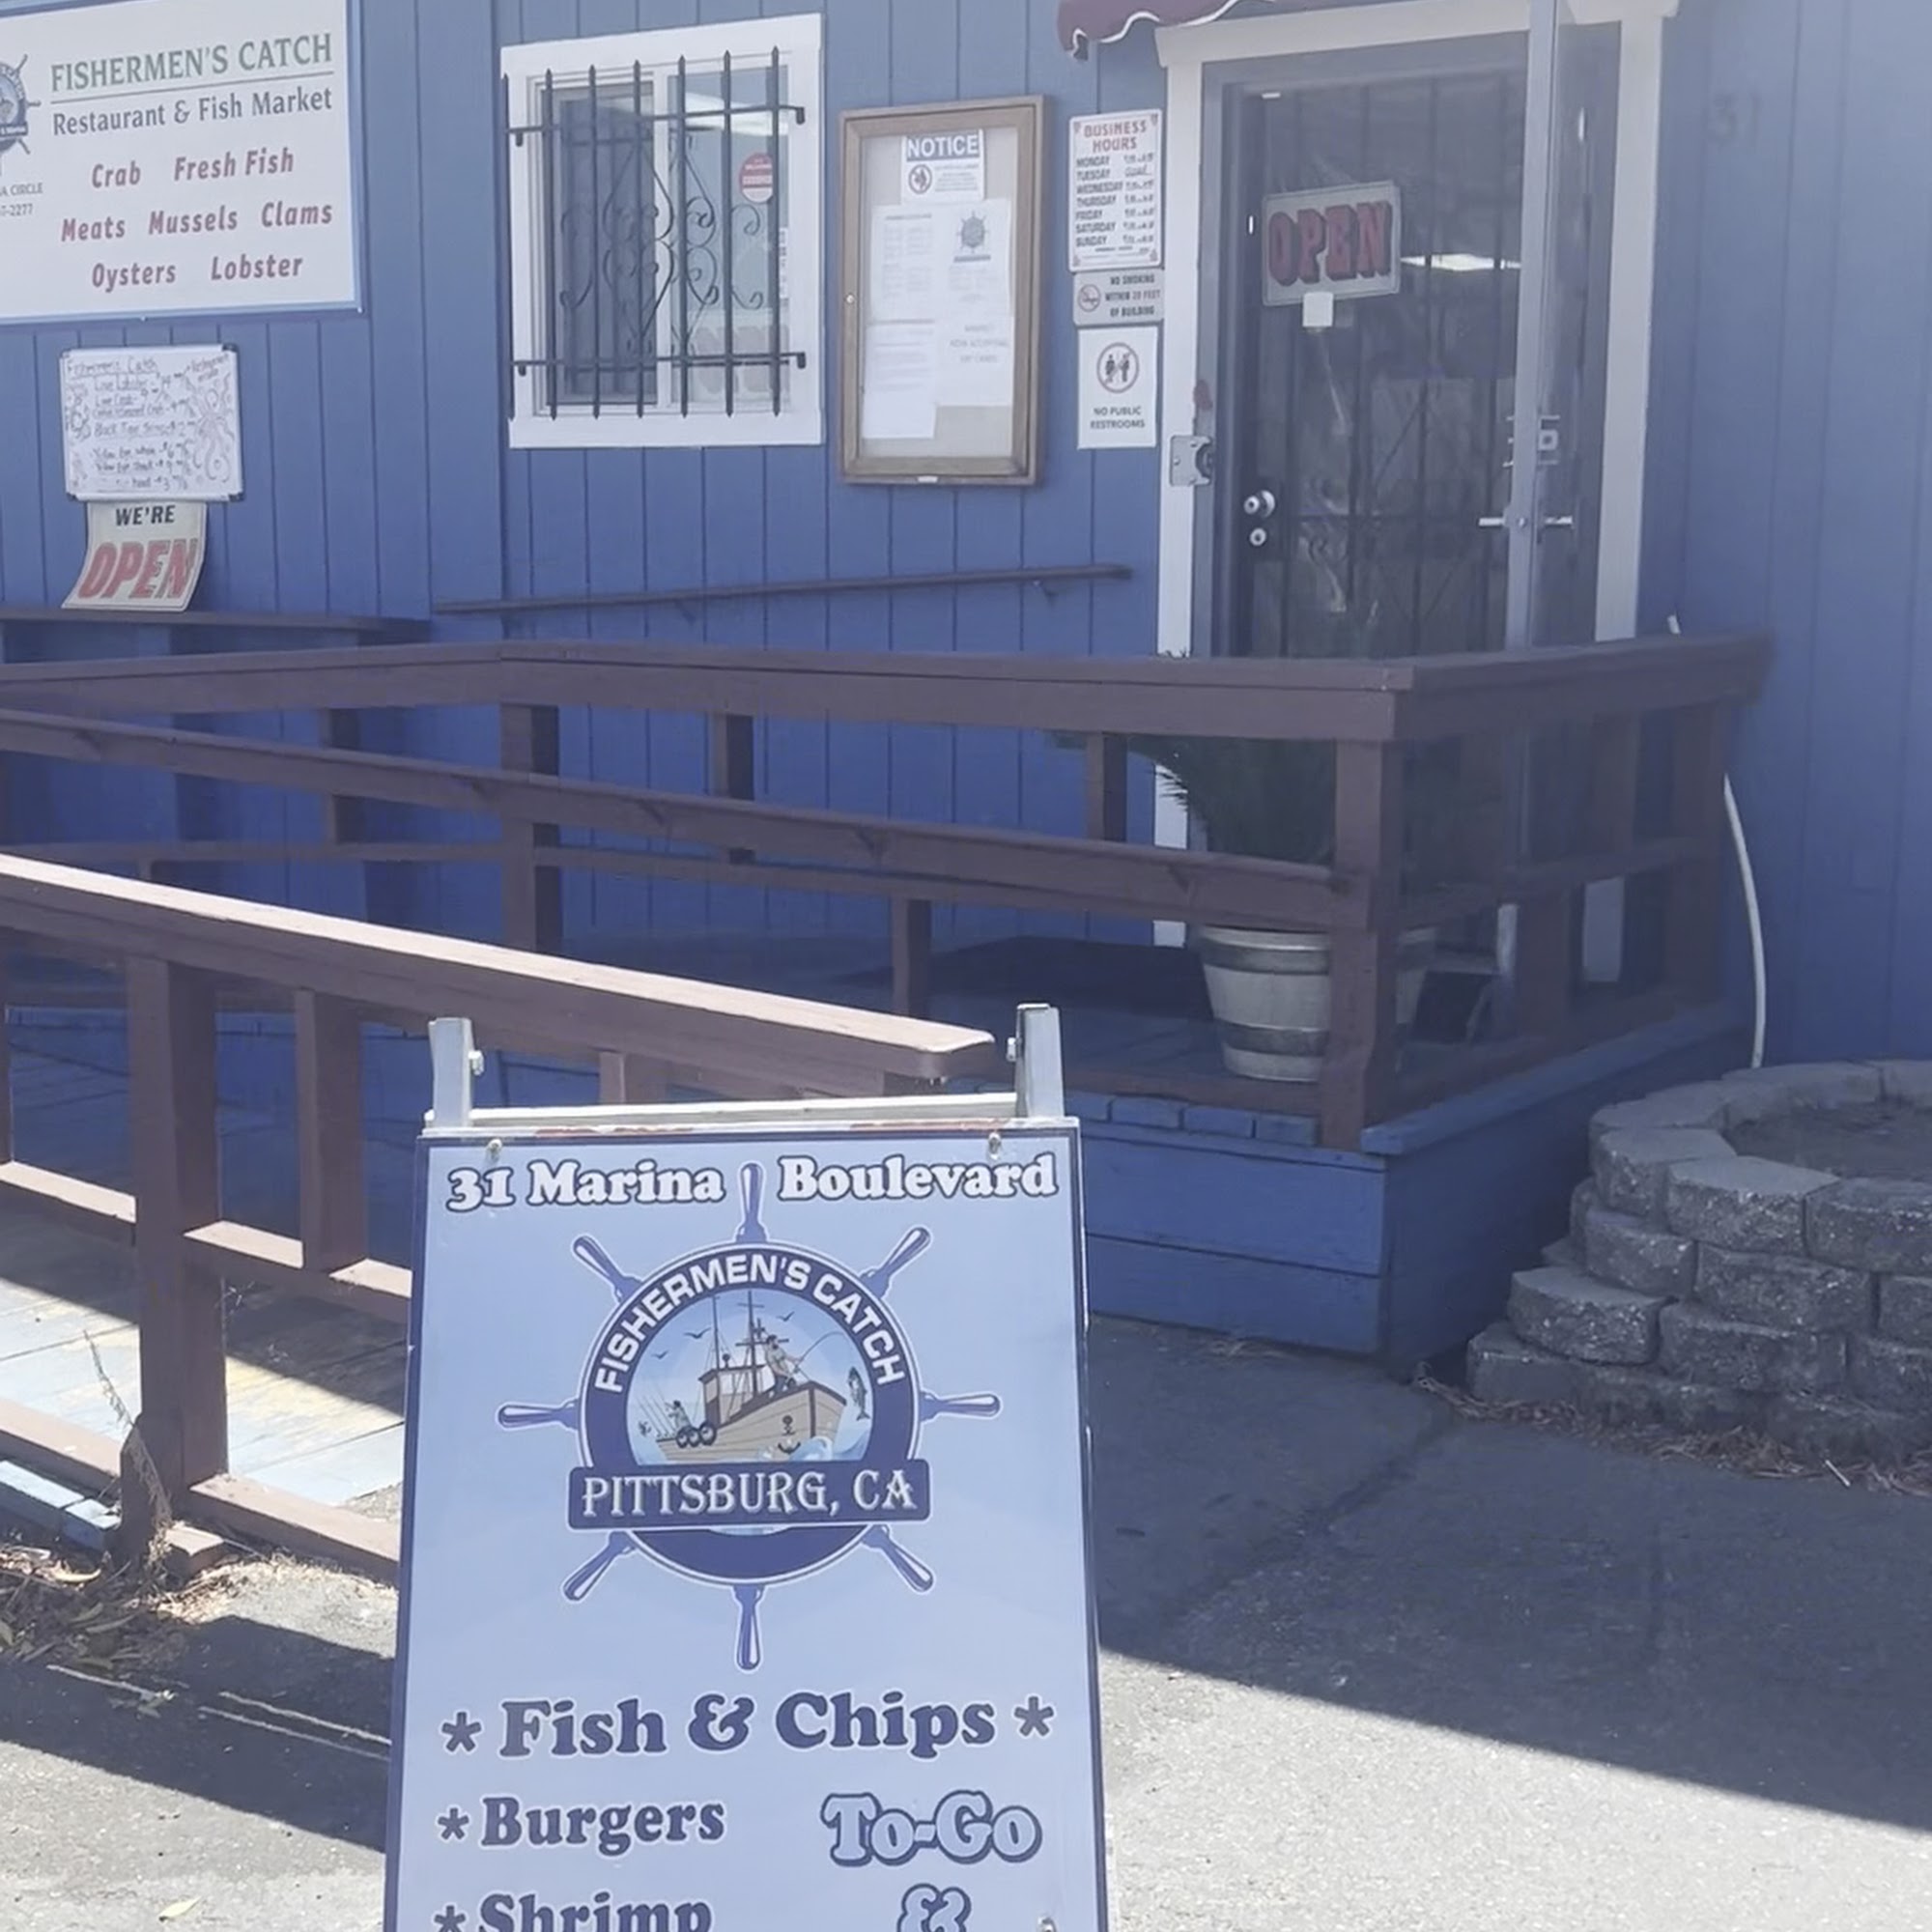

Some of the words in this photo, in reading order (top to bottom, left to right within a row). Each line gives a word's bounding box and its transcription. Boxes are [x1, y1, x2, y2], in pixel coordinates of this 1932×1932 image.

[51, 45, 228, 92] FISHERMEN'S
[238, 33, 332, 71] CATCH
[53, 104, 165, 135] Restaurant
[174, 99, 190, 124] &
[199, 93, 242, 121] Fish
[252, 86, 332, 116] Market
[1084, 120, 1148, 138] BUSINESS
[907, 133, 980, 158] NOTICE
[1093, 136, 1138, 154] HOURS
[92, 160, 141, 188] Crab
[174, 152, 236, 181] Fresh
[244, 147, 294, 176] Fish
[10, 183, 43, 196] CIRCLE
[61, 216, 126, 242] Meats
[149, 206, 238, 235] Mussels
[261, 200, 332, 228] Clams
[1268, 200, 1393, 287] OPEN
[92, 262, 176, 293] Oysters
[211, 253, 302, 280] Lobster
[1122, 274, 1155, 285] SMOKING
[1122, 305, 1155, 317] BUILDING
[1090, 419, 1146, 430] RESTROOMS
[1094, 407, 1108, 416] NO
[1110, 406, 1142, 416] PUBLIC
[115, 504, 176, 526] WE'RE
[77, 538, 198, 600] OPEN
[445, 1164, 516, 1212] 31
[526, 1158, 724, 1206] Marina
[777, 1152, 1060, 1202] Boulevard
[594, 1254, 811, 1393] FISHERMEN'S
[811, 1272, 906, 1385] CATCH
[582, 1471, 839, 1519] PITTSBURG,
[852, 1468, 918, 1511] CA
[498, 1697, 668, 1757] Fish
[688, 1693, 754, 1751] &
[776, 1690, 995, 1759] Chips
[481, 1796, 724, 1857] Burgers
[821, 1789, 1043, 1867] To-Go
[479, 1891, 712, 1932] Shrimp
[896, 1883, 972, 1932] &
